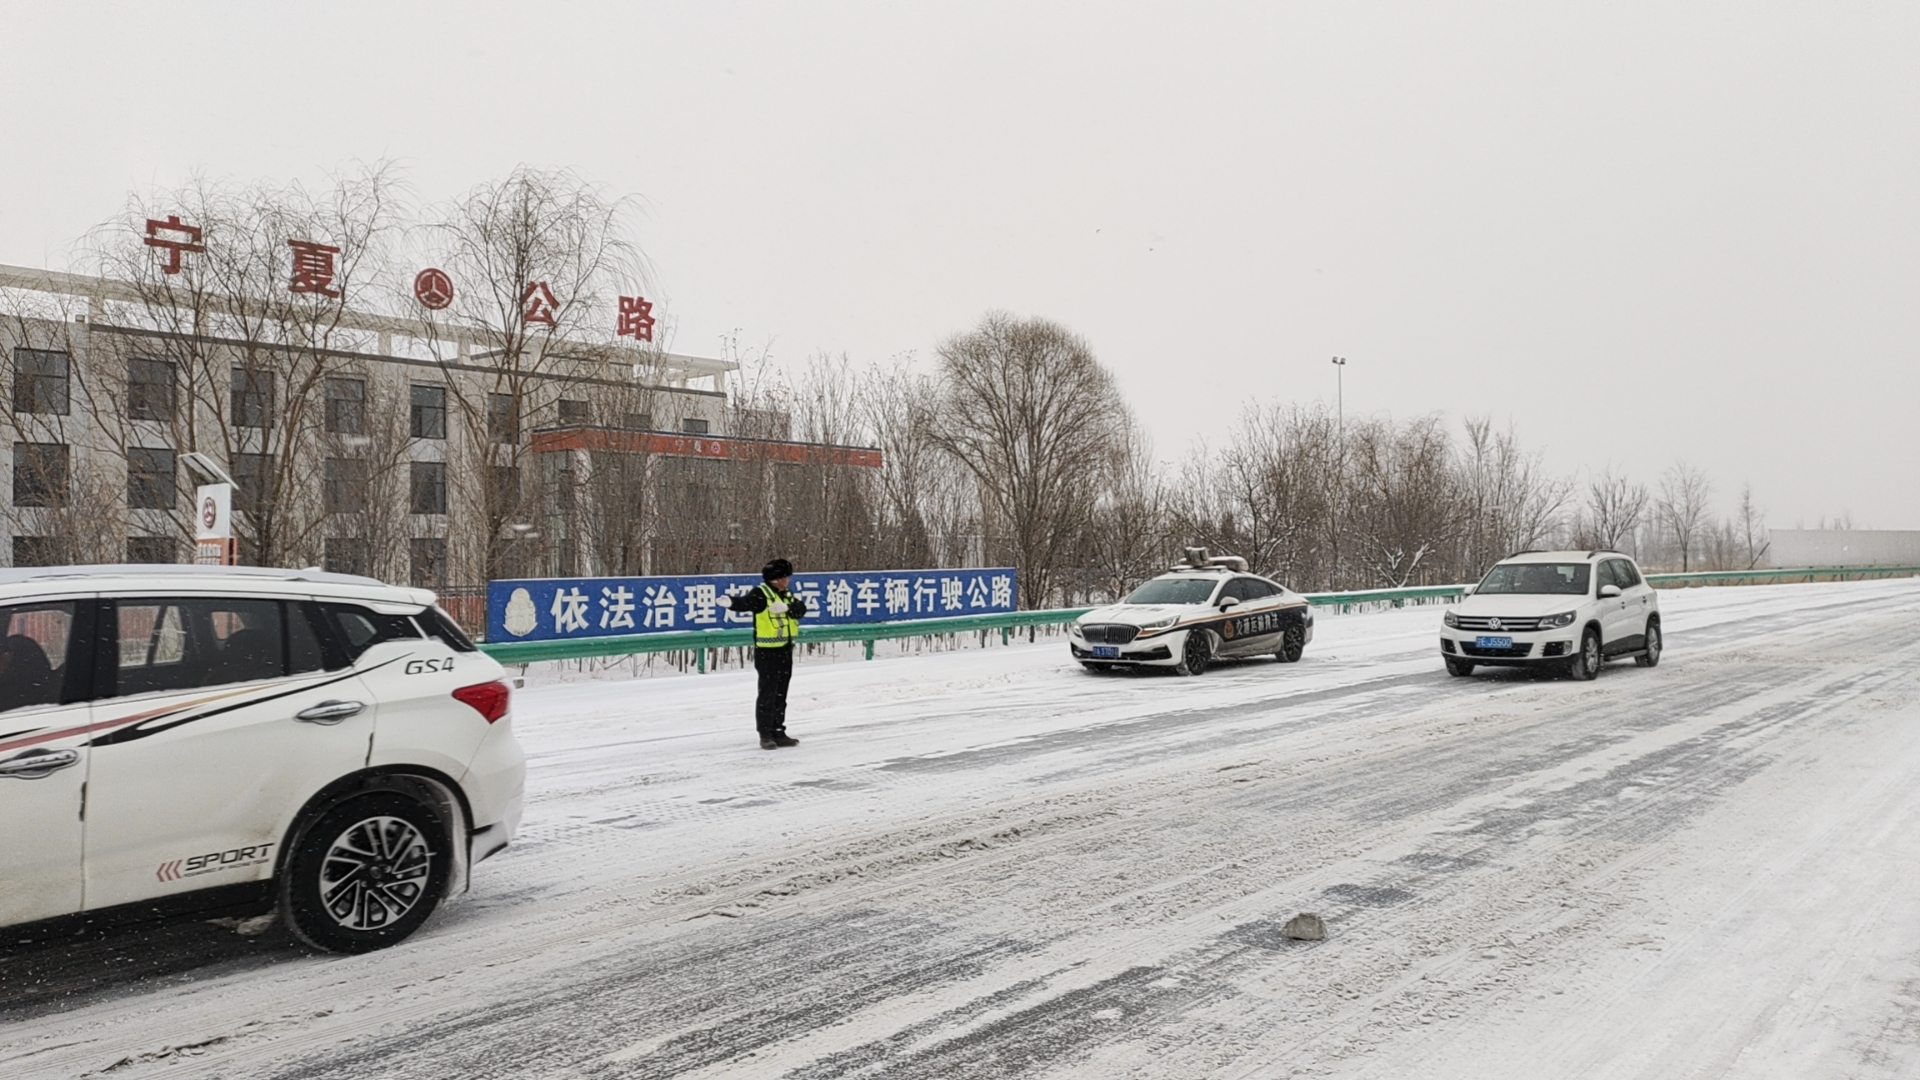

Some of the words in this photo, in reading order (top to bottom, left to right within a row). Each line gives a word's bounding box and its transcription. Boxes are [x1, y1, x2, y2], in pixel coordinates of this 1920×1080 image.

[144, 215, 340, 298] 宁夏
[524, 281, 655, 341] 公路
[550, 574, 1012, 633] 依法治理超运输车辆行驶公路
[405, 657, 454, 674] GS4
[186, 842, 275, 871] SPORT
